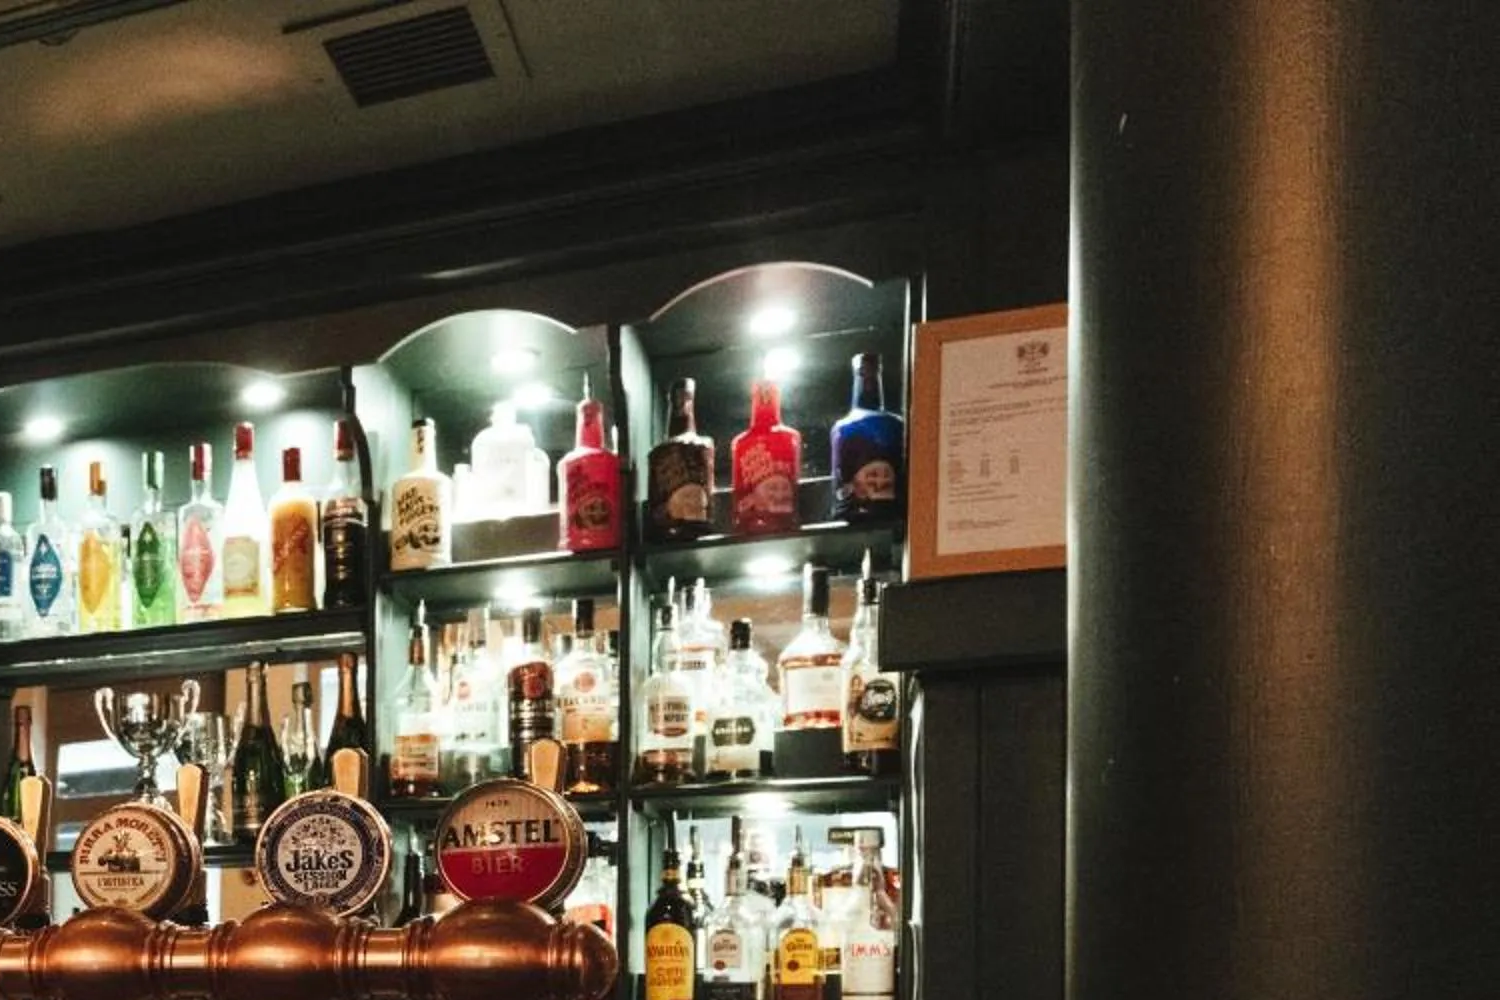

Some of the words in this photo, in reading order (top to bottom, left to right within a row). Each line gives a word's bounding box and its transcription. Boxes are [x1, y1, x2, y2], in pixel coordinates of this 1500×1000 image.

[443, 819, 560, 850] AMSTEL
[471, 855, 525, 875] BIER
[294, 869, 347, 884] SESSION
